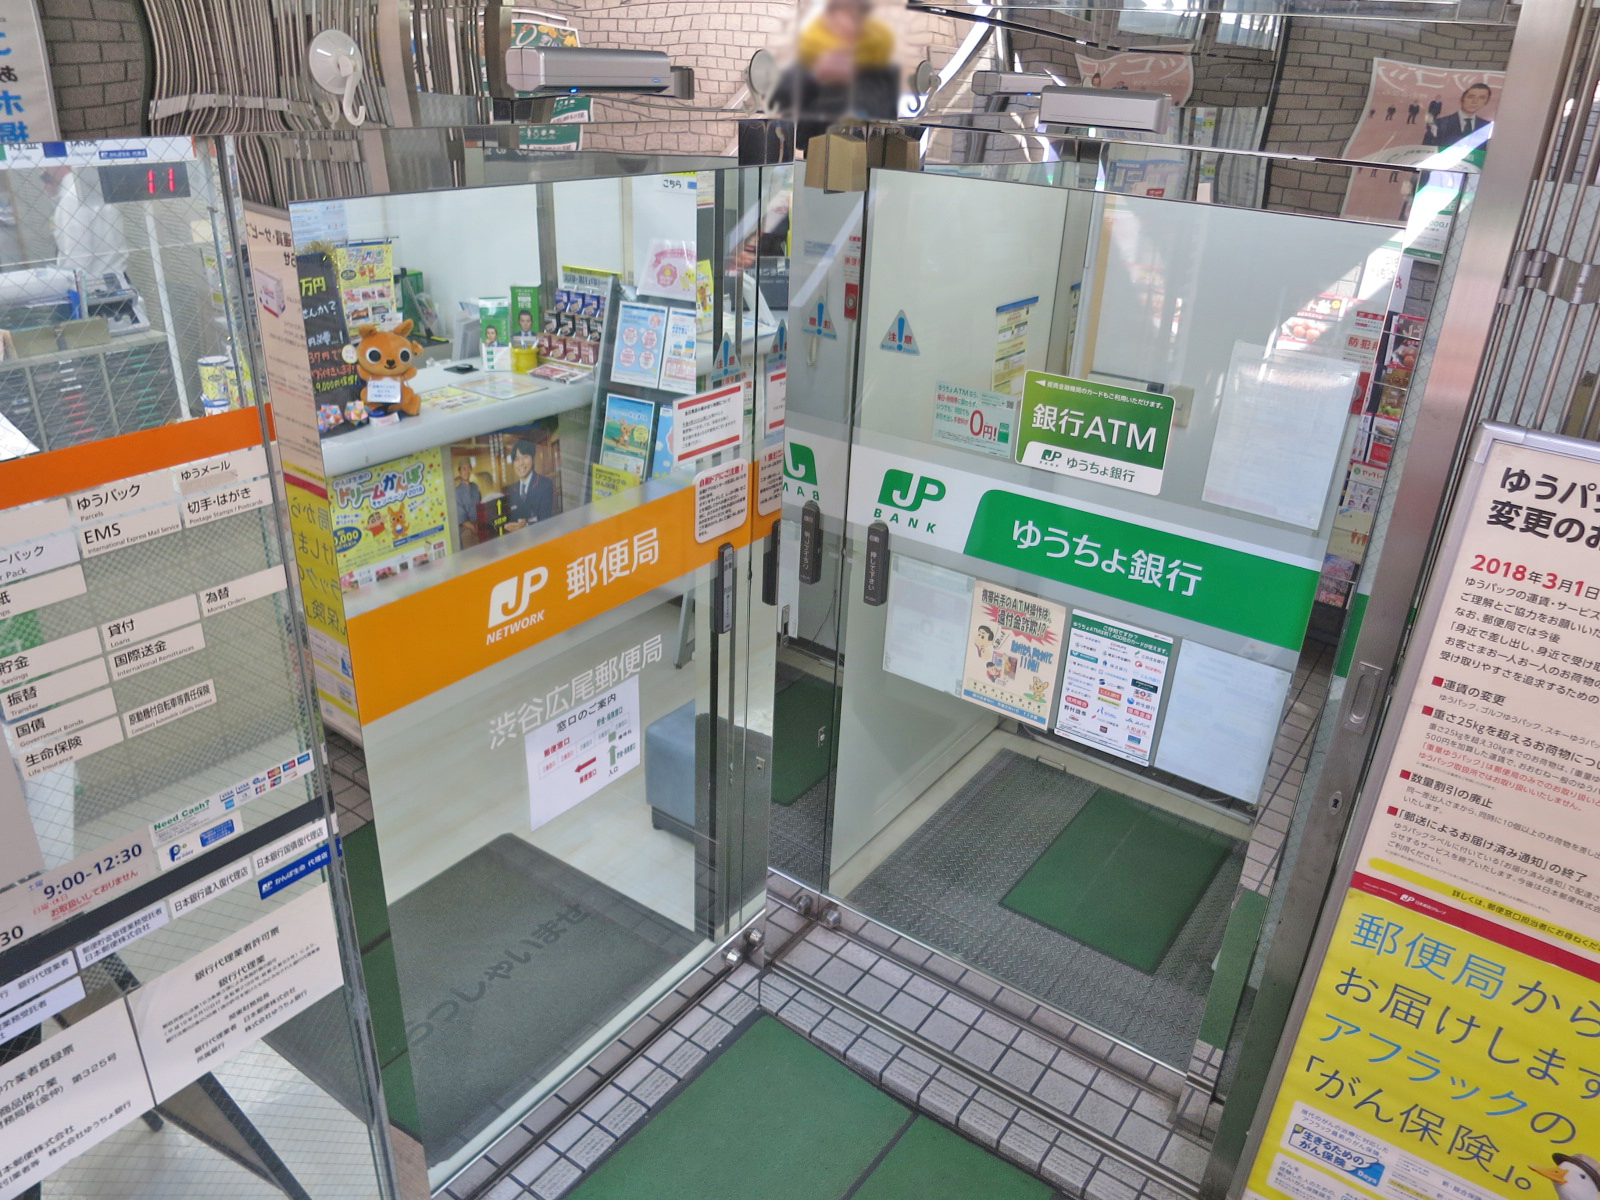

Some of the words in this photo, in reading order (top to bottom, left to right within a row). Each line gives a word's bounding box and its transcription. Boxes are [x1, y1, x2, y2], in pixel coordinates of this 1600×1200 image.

[147, 168, 175, 194] 11
[888, 331, 897, 343] 注
[1031, 402, 1157, 453] 銀行ATM
[180, 460, 231, 481] ゆうメール
[1066, 456, 1136, 484] ゆうちょ銀行
[187, 487, 252, 514] 切手・はがき
[877, 468, 947, 513] JP
[1500, 466, 1600, 513] ゆうパッ
[80, 511, 104, 522] Parcels
[189, 514, 213, 525] Postage
[213, 509, 233, 520] Stamps
[238, 499, 264, 512] Postcards
[873, 507, 937, 534] BANK
[84, 522, 122, 545] EMS
[88, 538, 125, 555] International
[126, 531, 147, 545] Express
[147, 529, 161, 541] Mail
[161, 523, 180, 536] Service
[6, 566, 28, 579] Pack
[566, 527, 660, 600] 郵便局
[1011, 518, 1204, 599] ゆうちょ銀行
[1469, 554, 1600, 600] 2018年3月1日
[205, 586, 230, 604] 為替
[207, 600, 227, 614] Money
[227, 595, 247, 608] Orders
[487, 565, 549, 629] JP
[1464, 576, 1600, 620] ゆうパックの運賃・サービス
[107, 619, 135, 639] 貸付
[486, 609, 545, 646] NETWORK
[1454, 606, 1561, 644] なお、郵便局では今後
[110, 636, 130, 648] Loans
[114, 640, 167, 668] 国際送金
[116, 657, 157, 678] International
[158, 645, 195, 664] Remittances
[1439, 650, 1600, 704] 受け取りやすさを追求するための
[1, 671, 29, 686] Savings
[490, 633, 663, 750] 渋谷広尾郵便局
[1442, 679, 1506, 708] 運賃の変更
[7, 685, 37, 708] 振替
[10, 702, 40, 718] Transfer
[128, 683, 212, 726] 原動機付自転車等責任保険
[15, 717, 46, 739] 国債
[556, 693, 617, 734] 窓口のご案内
[19, 728, 61, 748] Government
[60, 718, 84, 734] Bonds
[543, 737, 570, 758] 郵便窓口
[25, 735, 83, 768] 生命保険
[28, 767, 41, 778] Life
[41, 754, 74, 774] Insurance
[1402, 795, 1443, 815] いたします。
[1410, 772, 1494, 810] 数量割引の廃止
[153, 810, 179, 832] Need
[181, 799, 211, 823] Cash?
[1386, 840, 1442, 865] ご利用ください。
[1398, 808, 1588, 883] 「郵送によるお届け済み通知」の終了
[43, 842, 144, 900] 9:00-12:30
[274, 863, 307, 887] かんぽ生命
[307, 851, 330, 869] 代理店
[50, 869, 139, 918] お取扱いしておりません
[84, 921, 152, 961] 日本郵便株式会社
[194, 925, 281, 983] 銀行代理業者許可票
[17, 957, 70, 990] 銀行代理業者
[218, 954, 267, 988] 銀行代理業
[1350, 911, 1600, 1039] 郵便局から
[0, 1000, 48, 1031] 業務受託者
[1319, 1013, 1577, 1145] アフラックの
[1304, 1055, 1533, 1191] 「がん保険」。
[0, 1124, 76, 1178] 本郵便株式会社
[1298, 1140, 1348, 1169] がん保険
[1302, 1129, 1365, 1167] 生きるための
[1356, 1168, 1378, 1185] Days
